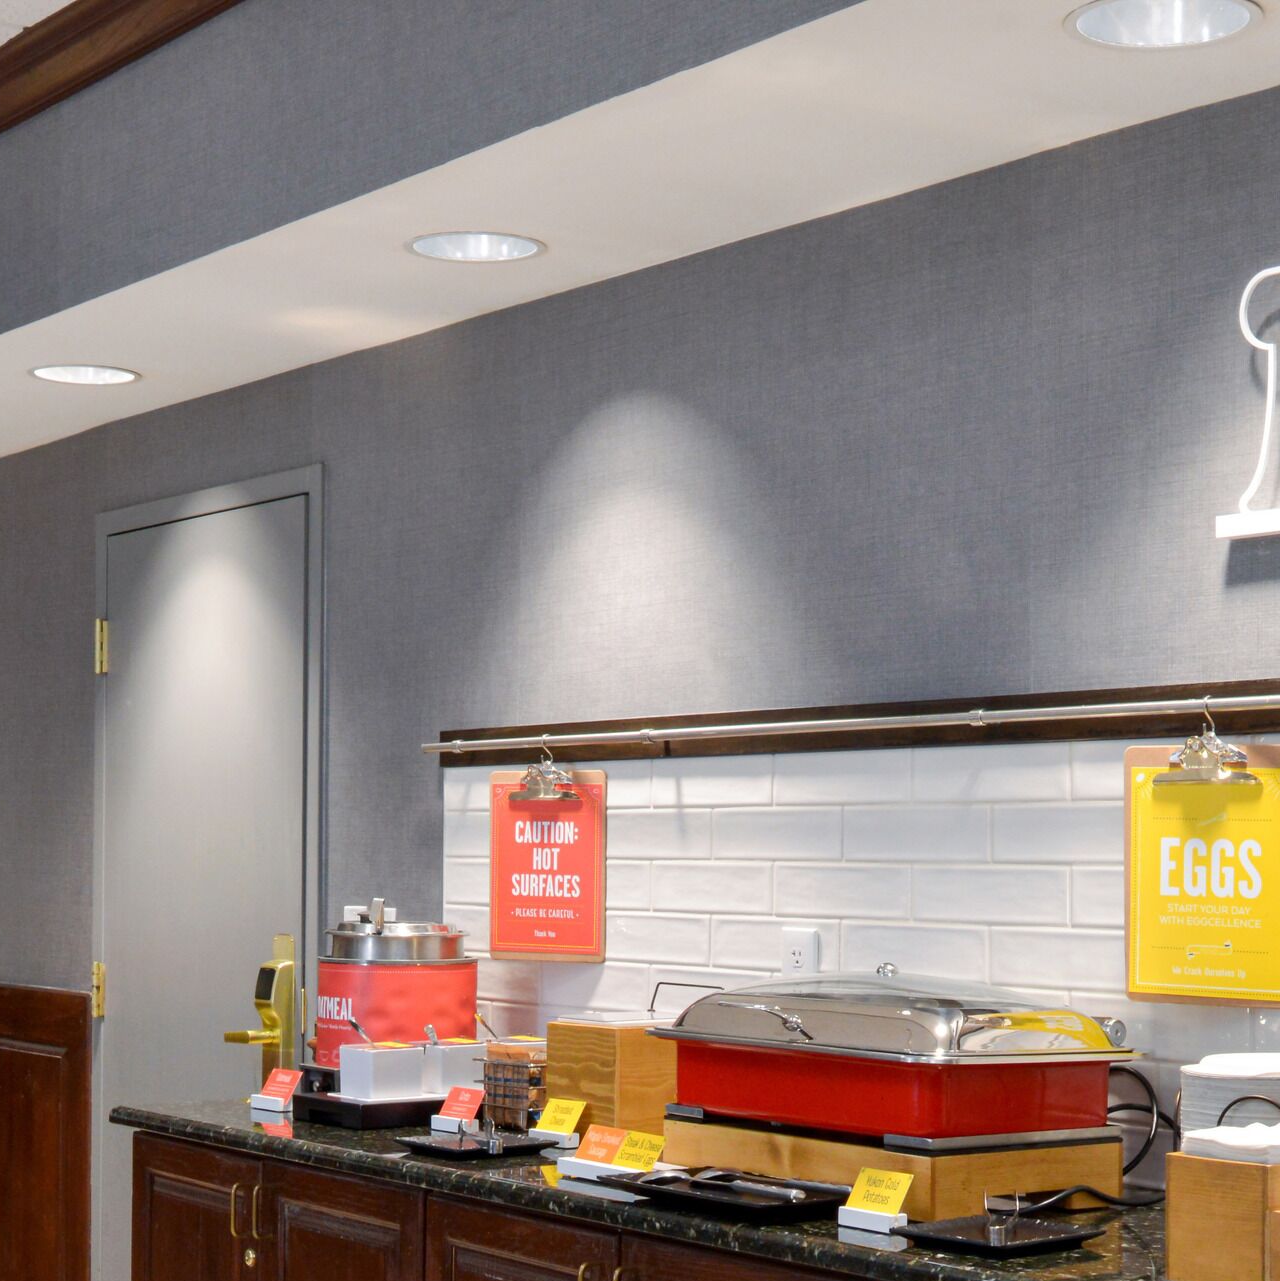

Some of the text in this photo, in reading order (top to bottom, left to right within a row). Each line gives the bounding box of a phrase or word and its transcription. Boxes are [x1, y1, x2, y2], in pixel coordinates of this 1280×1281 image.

[514, 820, 579, 844] CAUTION:
[532, 847, 560, 871] HOT
[1159, 836, 1263, 899] EGGS
[511, 873, 581, 898] SURFACES
[515, 907, 537, 918] PLEASE
[1167, 903, 1251, 915] START YOUR DAY
[1160, 915, 1262, 929] WITH EGGCELLENCE
